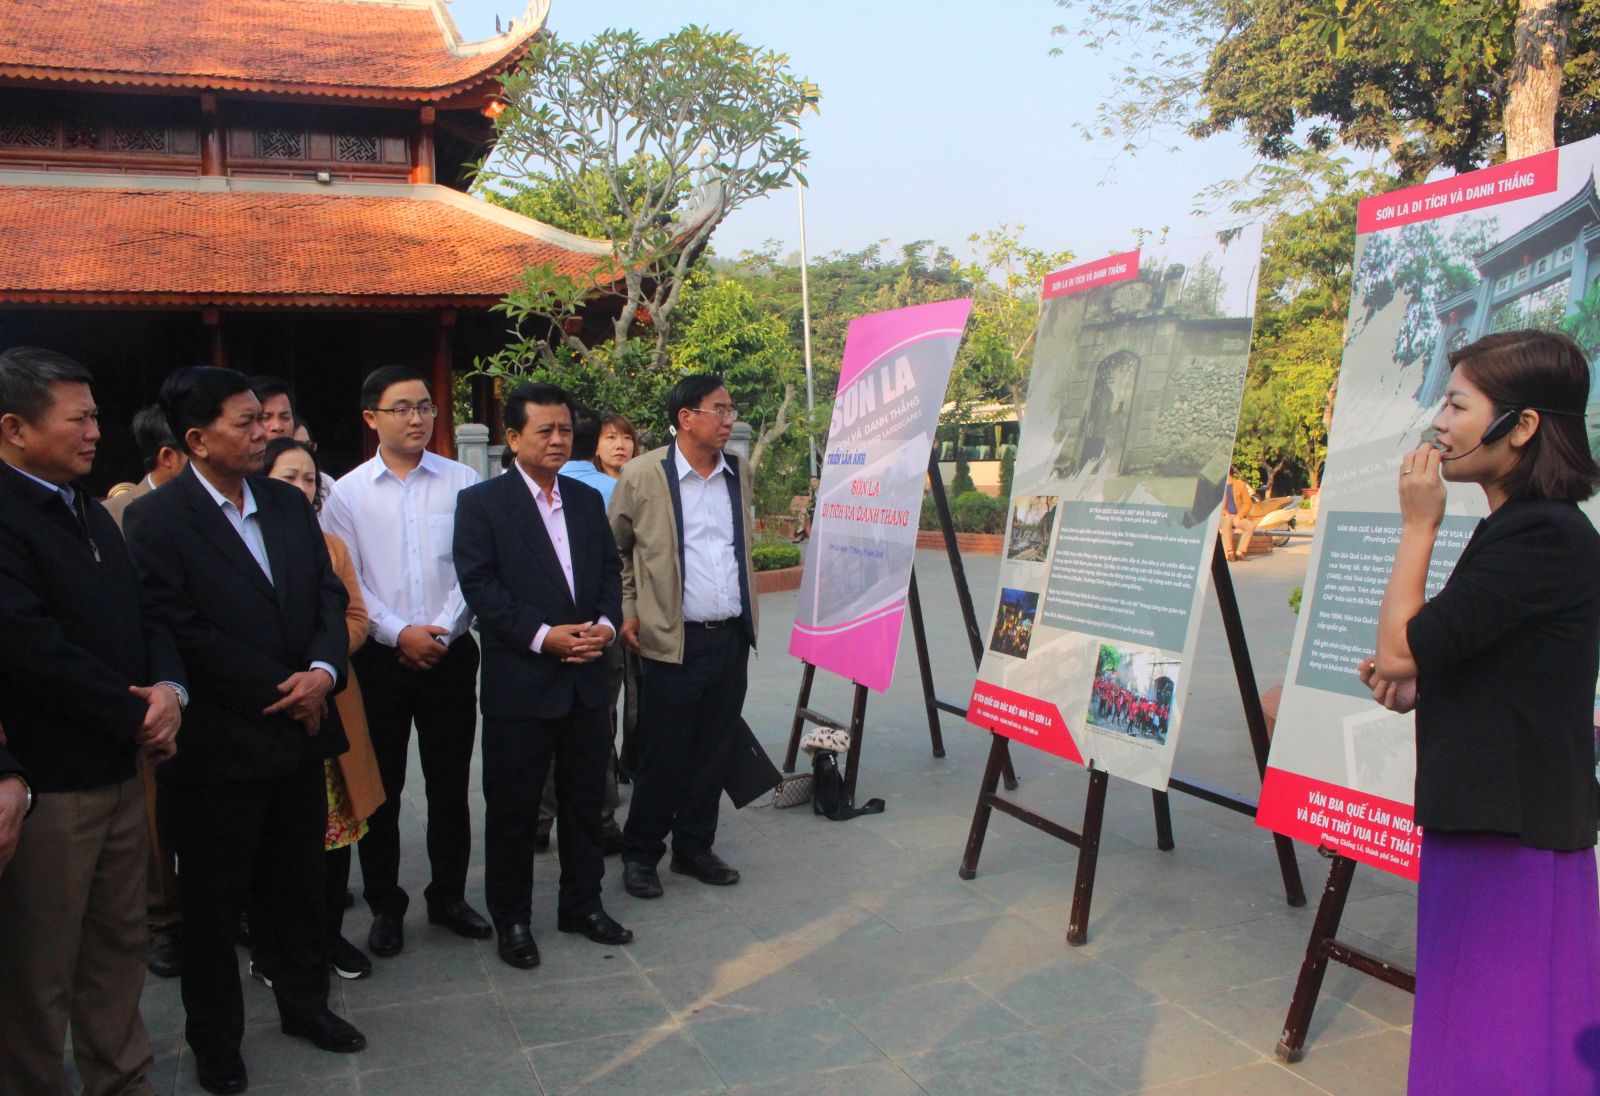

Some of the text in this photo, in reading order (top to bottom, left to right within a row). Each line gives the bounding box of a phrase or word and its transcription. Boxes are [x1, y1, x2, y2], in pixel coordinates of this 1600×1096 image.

[1376, 170, 1534, 221] SƠN LA DI TÍCH VÀ DANH THẮNG
[1052, 280, 1061, 291] SƠN
[1062, 280, 1068, 288] LA
[1068, 278, 1074, 287] DI
[1075, 273, 1085, 286] TÍCH
[1086, 270, 1092, 282] VÀ
[1093, 268, 1106, 279] DANH
[829, 356, 916, 437] SƠN LA
[864, 415, 888, 435] DANH
[890, 396, 920, 419] THẮNG
[869, 482, 880, 496] LA
[857, 506, 880, 523] DANH
[1371, 526, 1383, 534] LÂM
[1045, 718, 1051, 727] LA
[1309, 791, 1326, 807] VĂN
[1328, 797, 1344, 812] BIA
[1346, 802, 1368, 819] QUẾ
[1368, 808, 1390, 823] LÂM
[1392, 817, 1414, 836] NGỰ
[1297, 806, 1308, 822] VÀ
[1310, 811, 1328, 828] ĐỀN
[1332, 819, 1352, 834] THỜ
[1353, 827, 1371, 842] VUA
[1374, 830, 1387, 847] LÊ
[1391, 835, 1414, 855] THÁI
[1365, 846, 1379, 857] thành
[1379, 851, 1390, 860] phố
[1390, 855, 1400, 864] Sơn
[1400, 858, 1409, 867] La)
